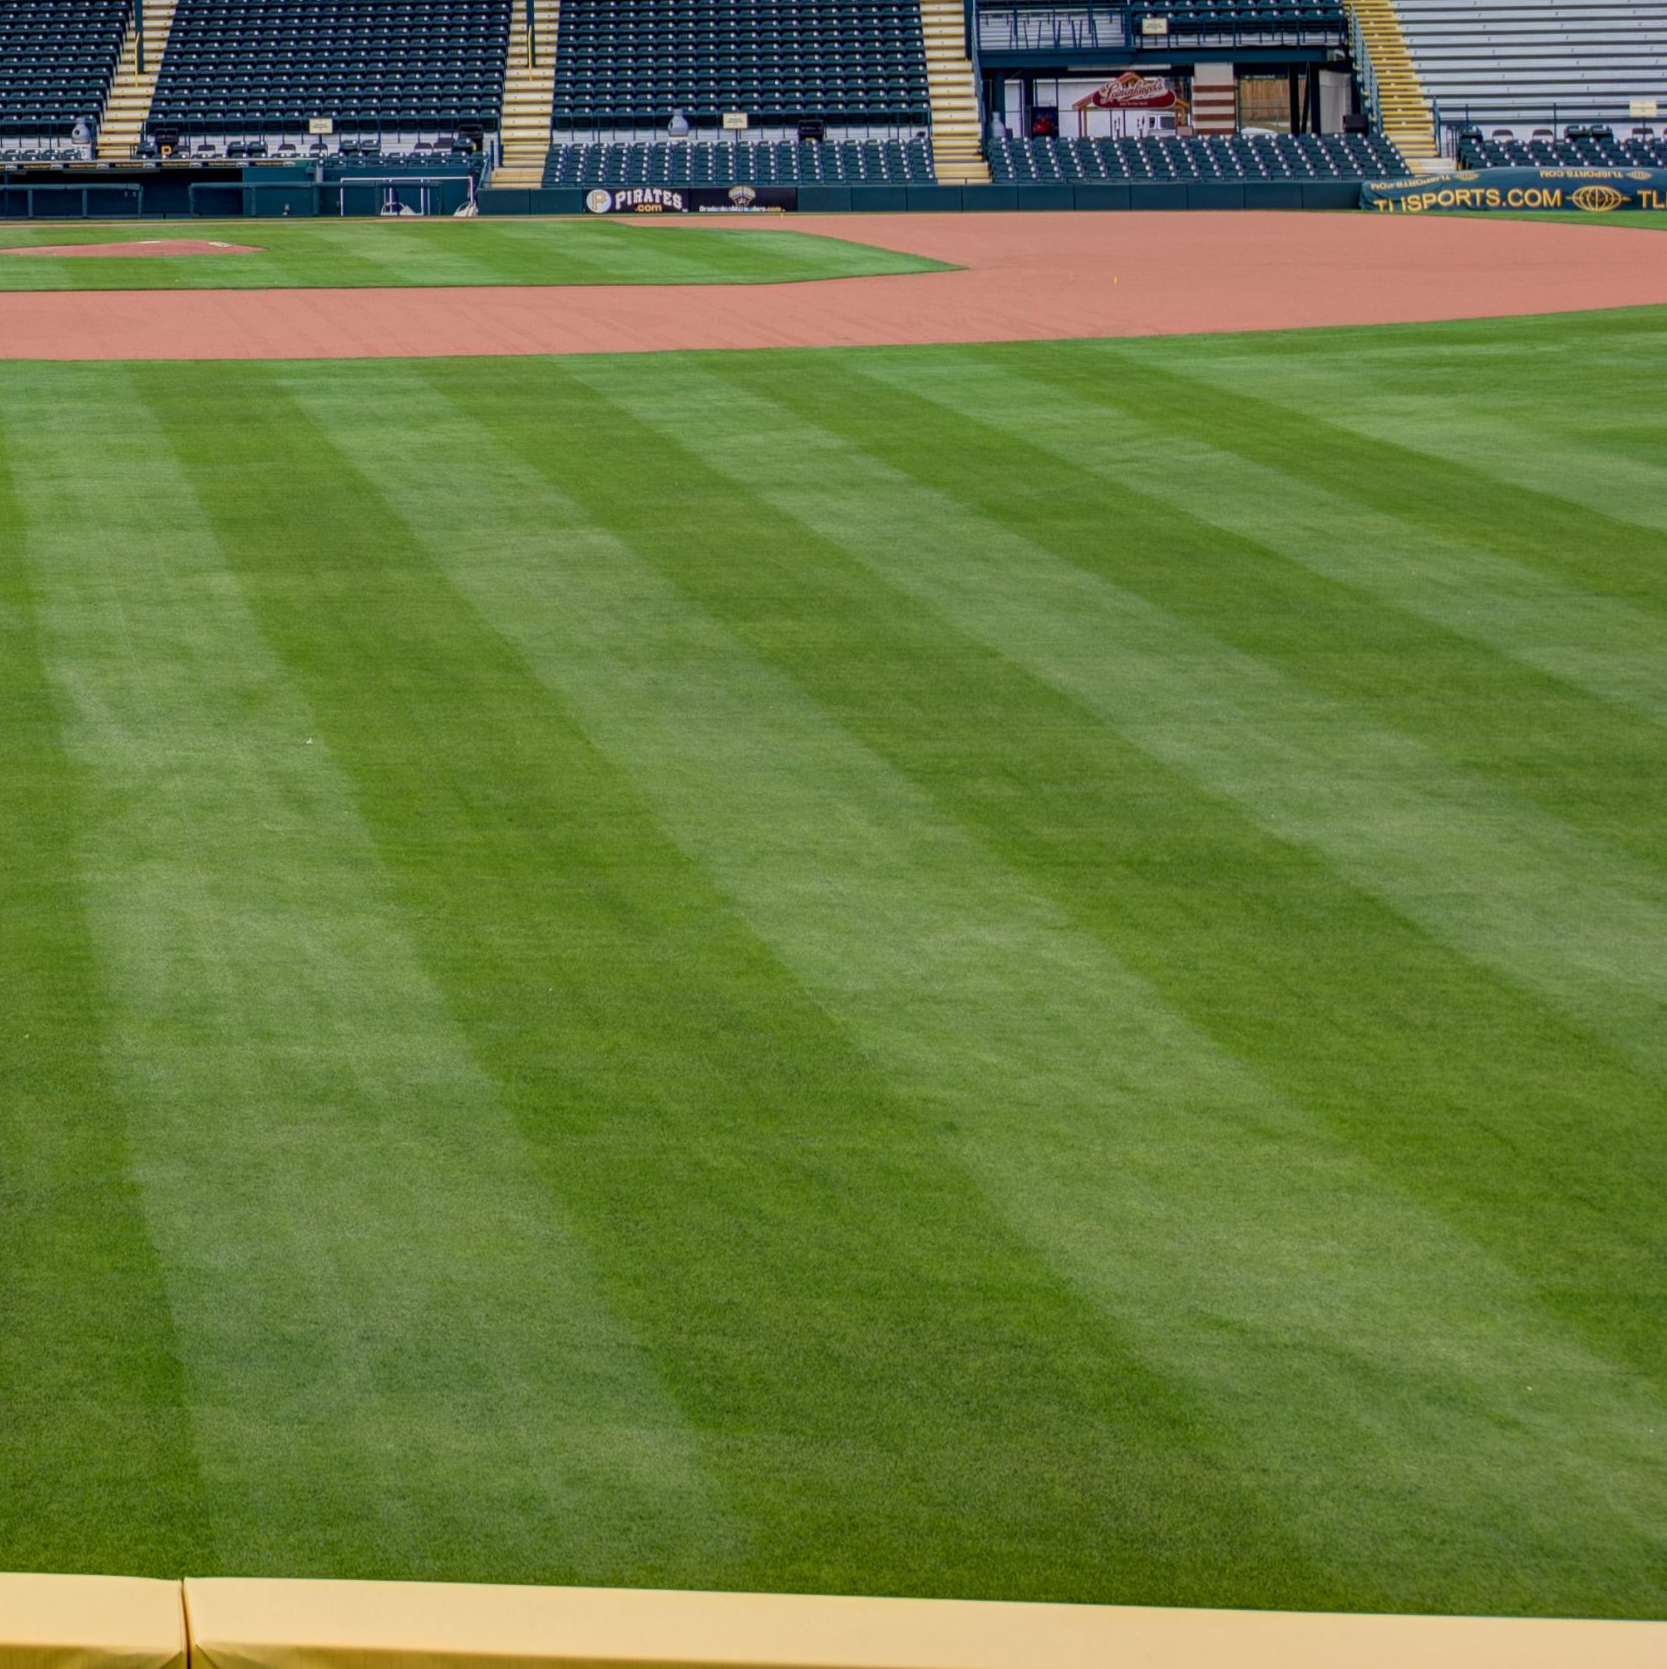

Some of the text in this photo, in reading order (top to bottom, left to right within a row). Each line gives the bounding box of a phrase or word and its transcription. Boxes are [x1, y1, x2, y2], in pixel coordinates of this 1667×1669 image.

[615, 189, 682, 210] PIRATES
[635, 204, 662, 212] .com
[1637, 190, 1667, 209] TL
